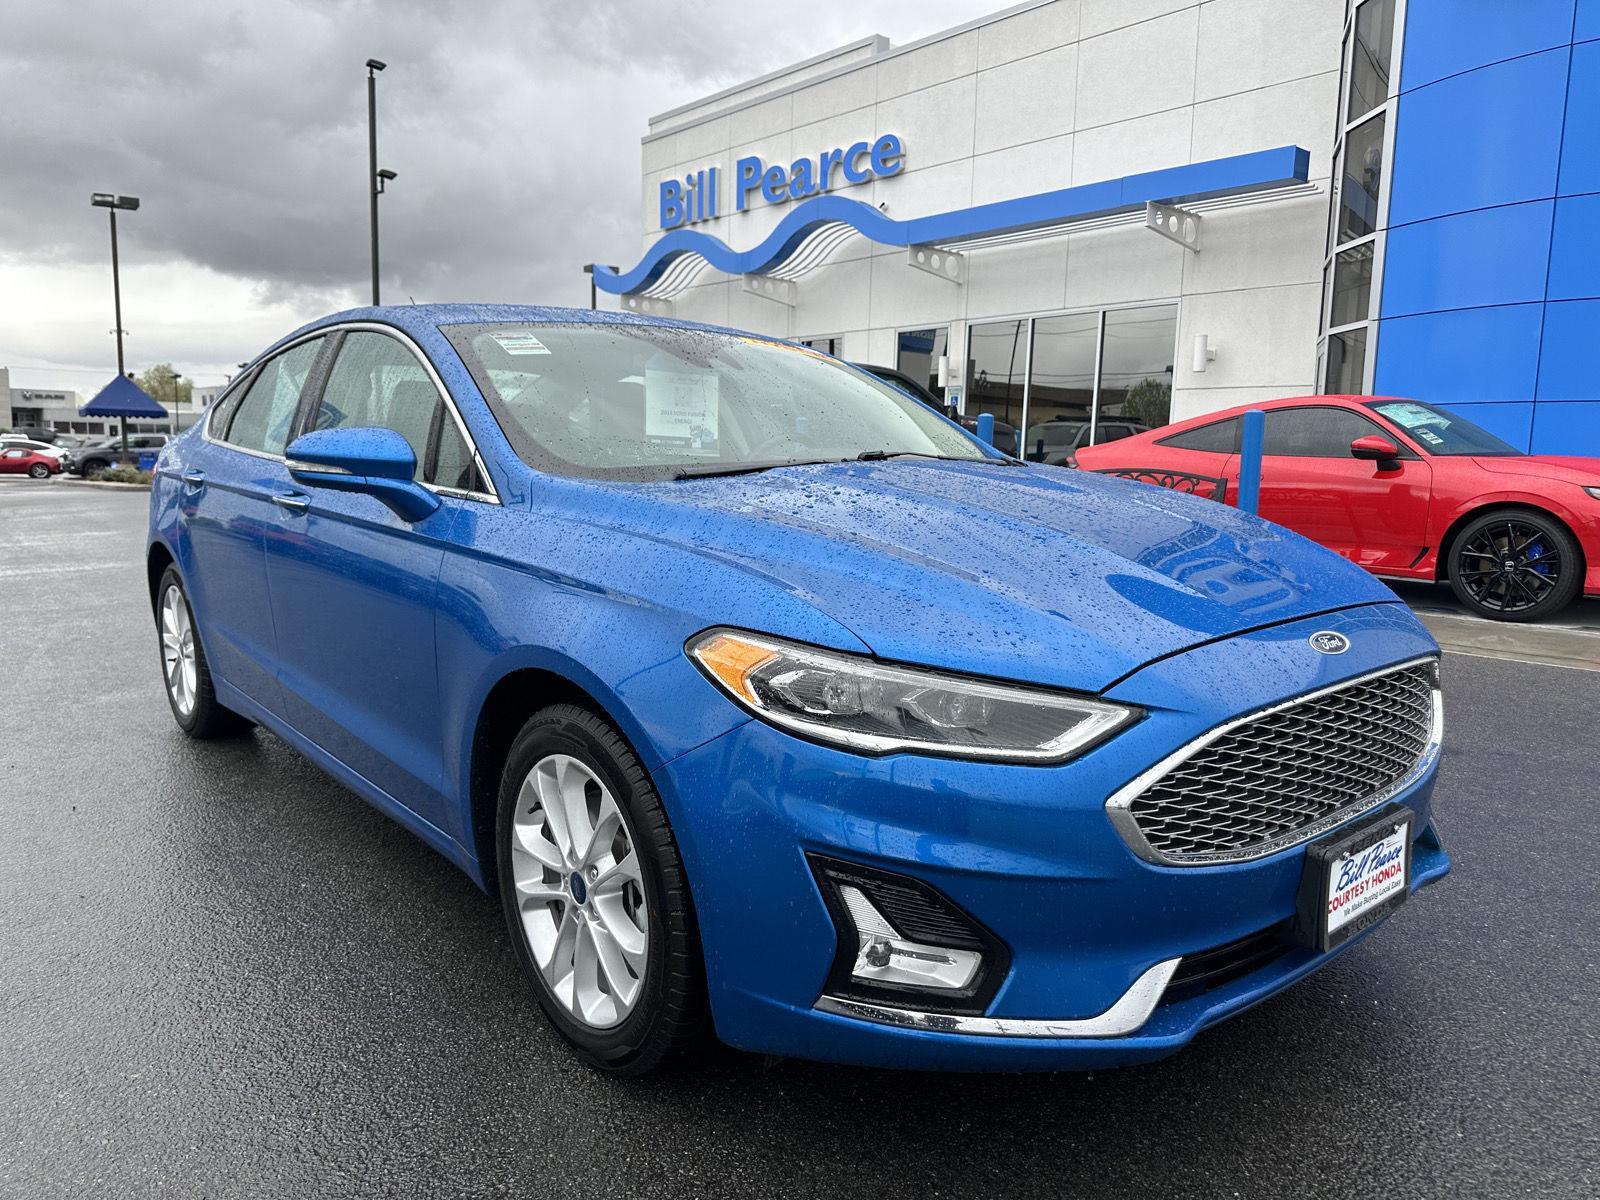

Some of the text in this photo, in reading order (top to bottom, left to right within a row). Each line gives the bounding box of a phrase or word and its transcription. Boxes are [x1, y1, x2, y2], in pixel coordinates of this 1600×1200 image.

[660, 134, 904, 229] Bill Pearce
[1328, 861, 1402, 914] COURTESY HONDA
[1336, 842, 1402, 893] Bill Pearce
[1379, 883, 1391, 895] Local
